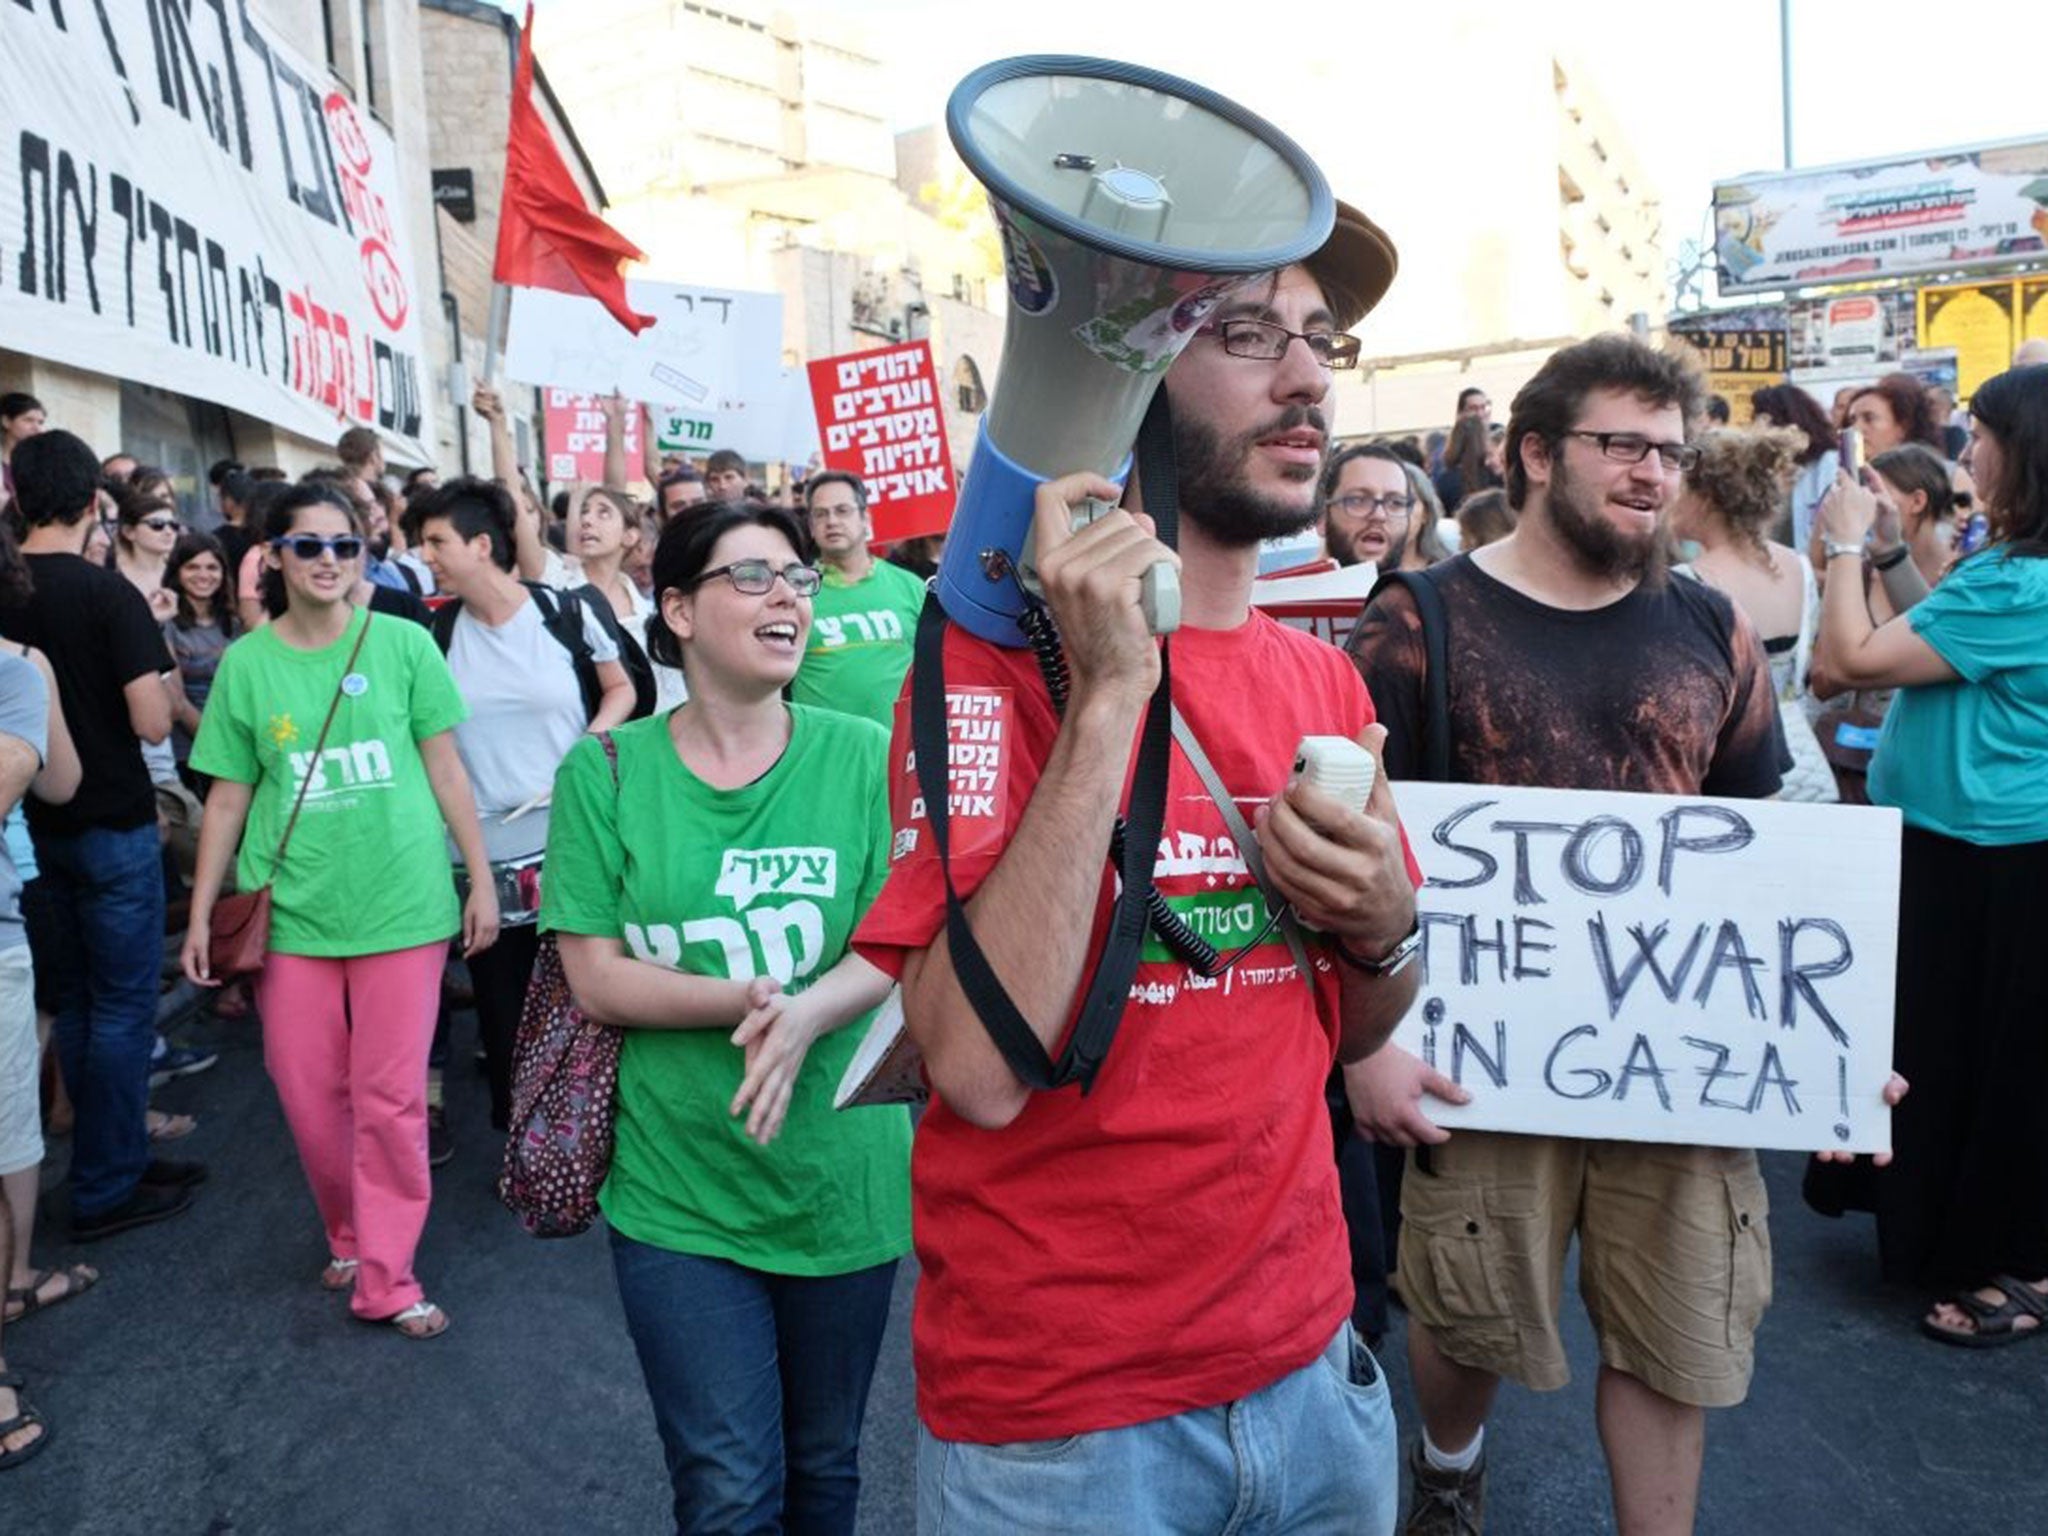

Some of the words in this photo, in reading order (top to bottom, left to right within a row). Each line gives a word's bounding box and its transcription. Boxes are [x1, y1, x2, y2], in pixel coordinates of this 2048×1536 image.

[19, 129, 101, 315] את
[110, 172, 236, 362] תחזיר
[239, 255, 289, 386] לא
[287, 285, 374, 424] נקמה
[837, 348, 925, 390] יהודים
[374, 338, 421, 439] שום
[833, 377, 933, 420] וערבים
[668, 417, 713, 440] מרצ
[826, 407, 939, 452] מסרבים
[862, 434, 941, 475] להיות
[814, 610, 902, 647] מרצ
[945, 694, 1002, 716] יהוד
[289, 739, 392, 791] מרצ
[1423, 801, 1755, 905] STOP
[1418, 911, 1556, 986] THE
[1587, 910, 1853, 1048] WAR
